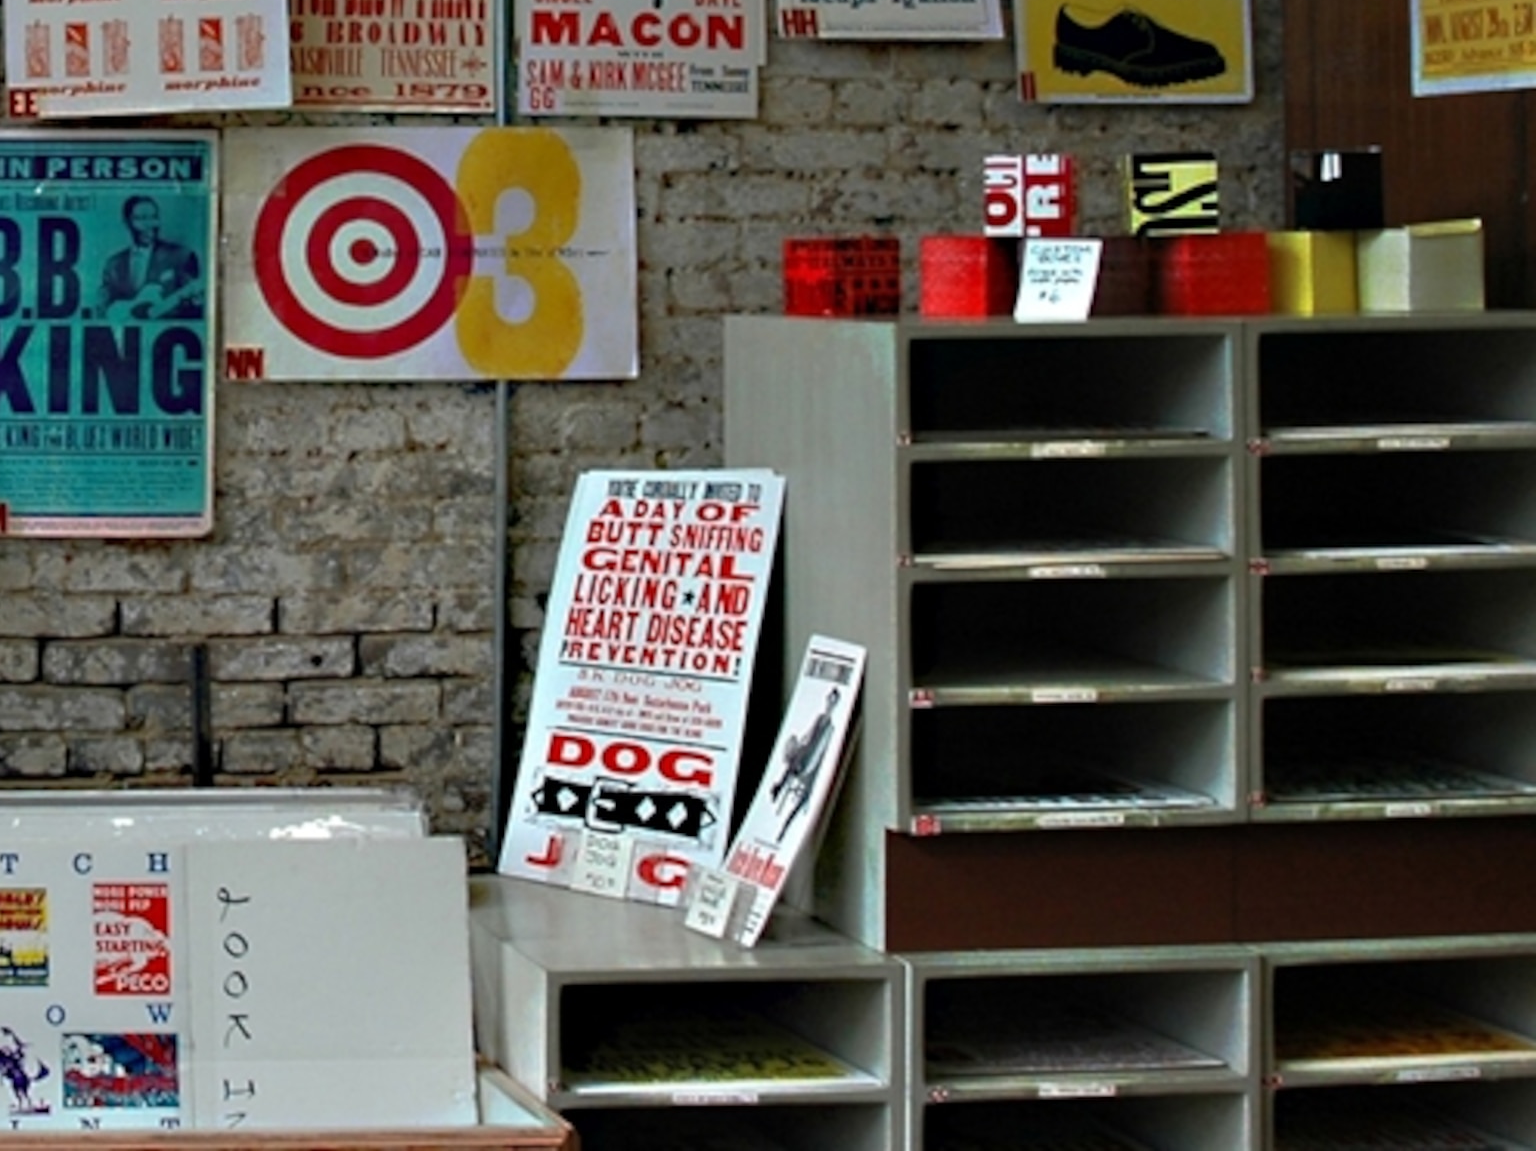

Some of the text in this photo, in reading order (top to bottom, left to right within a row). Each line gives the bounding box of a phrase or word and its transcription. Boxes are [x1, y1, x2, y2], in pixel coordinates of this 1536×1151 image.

[531, 12, 744, 49] MACON
[394, 83, 488, 98] 1879
[454, 126, 585, 378] 3
[586, 522, 664, 547] BUTT
[582, 549, 755, 581] GENITAL
[573, 574, 750, 615] LICKING AND
[565, 606, 748, 651] HEART DISEASE
[546, 733, 714, 788] DOG
[95, 939, 165, 953] STARTING
[96, 923, 130, 937] EASY
[115, 974, 168, 993] PECO
